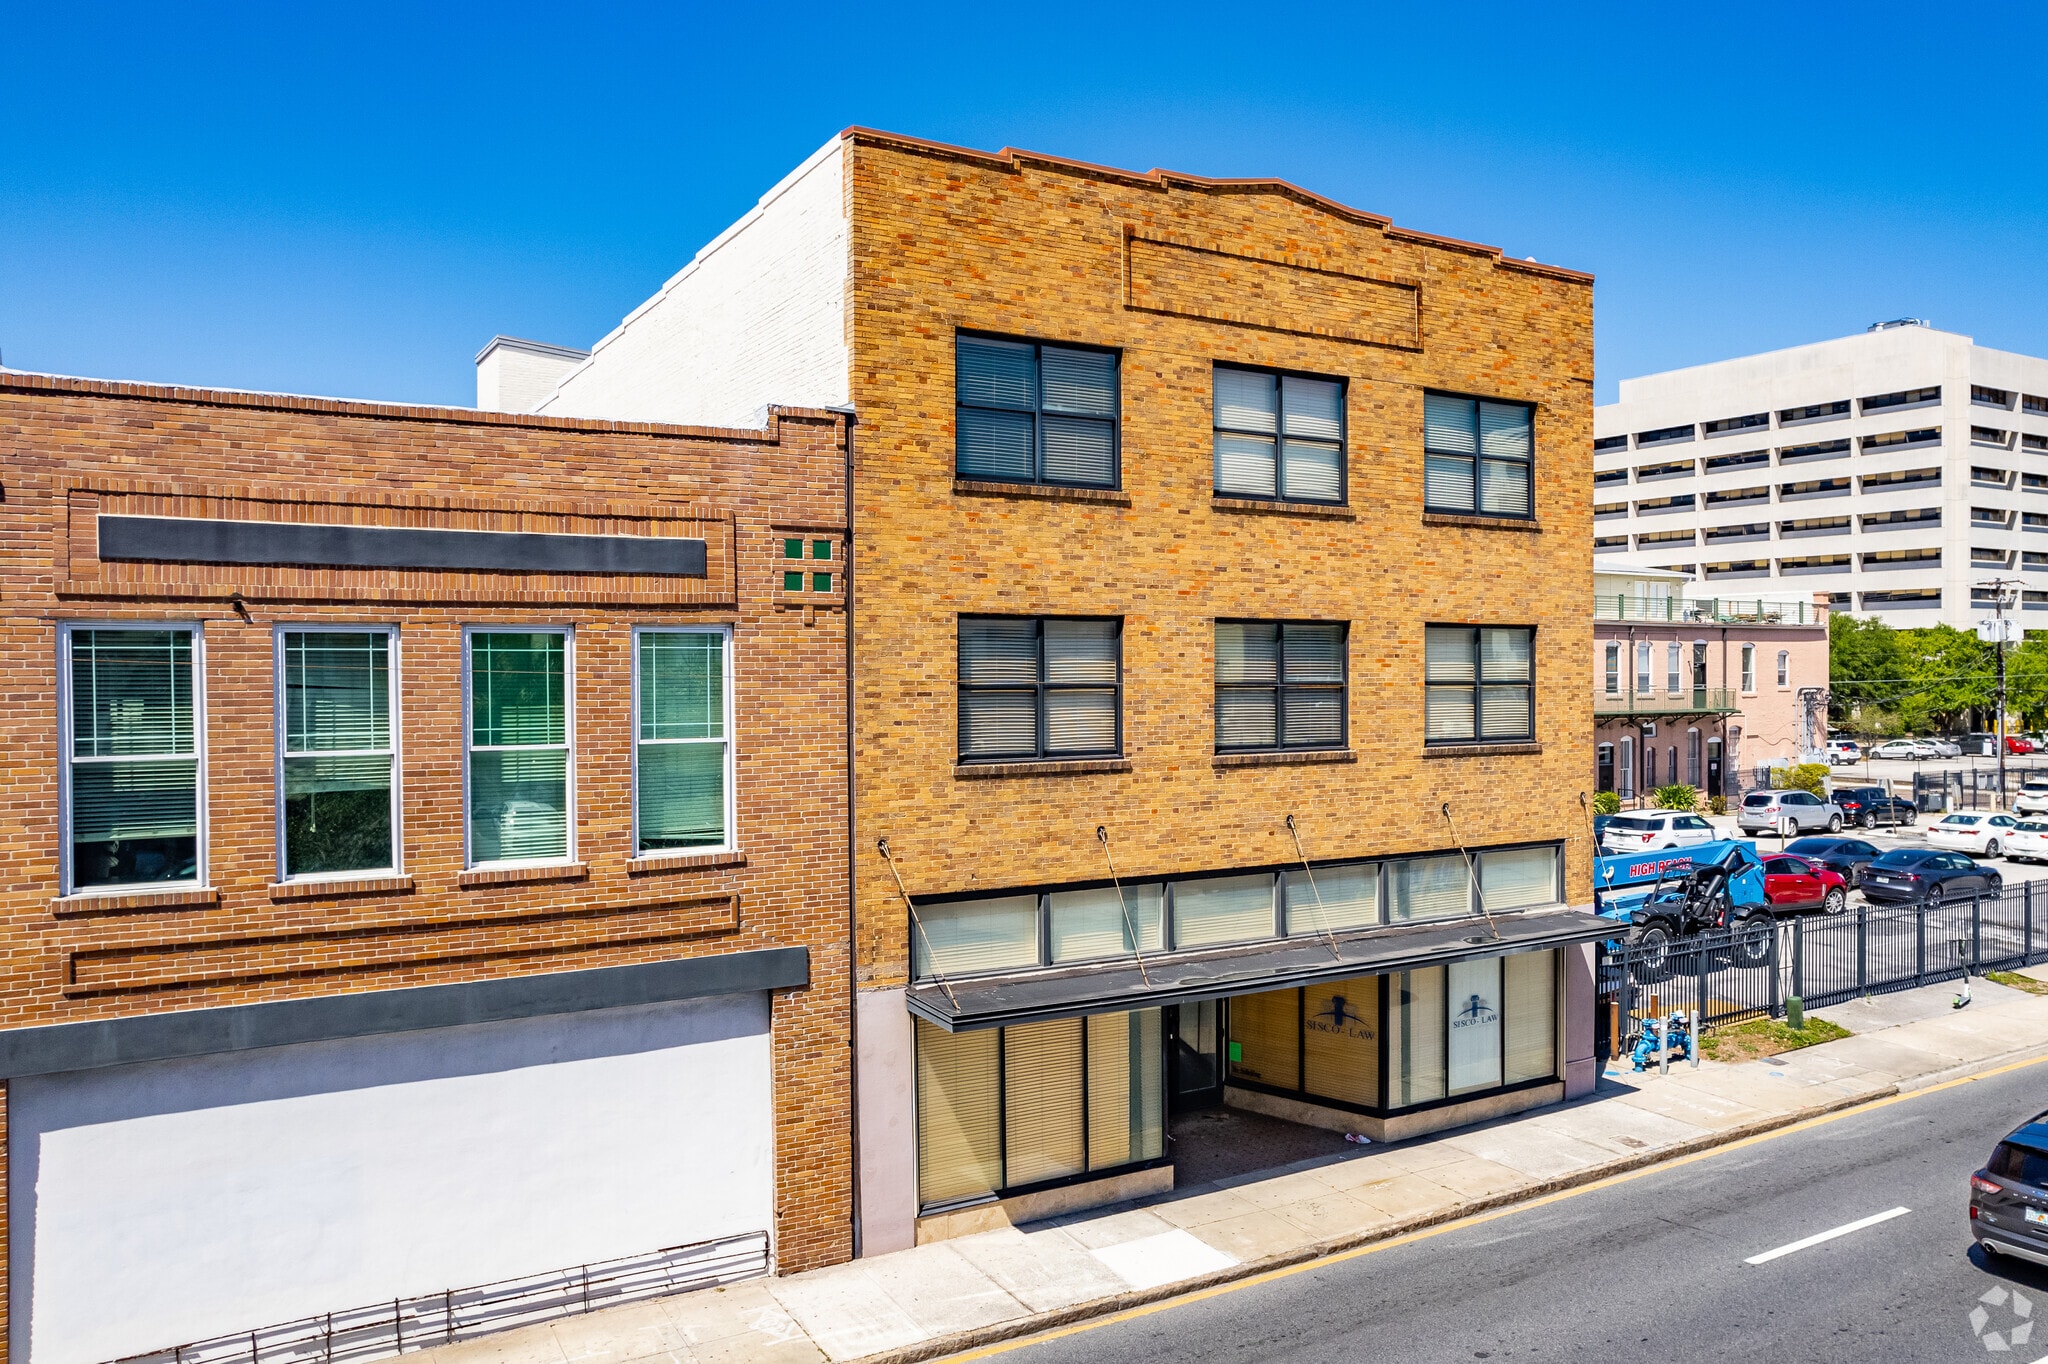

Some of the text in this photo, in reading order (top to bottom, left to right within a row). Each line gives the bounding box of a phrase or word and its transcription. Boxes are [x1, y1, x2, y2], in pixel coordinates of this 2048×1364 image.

[1629, 861, 1656, 878] HIGH
[1481, 1014, 1497, 1023] LAW
[1349, 1028, 1375, 1040] LAW
